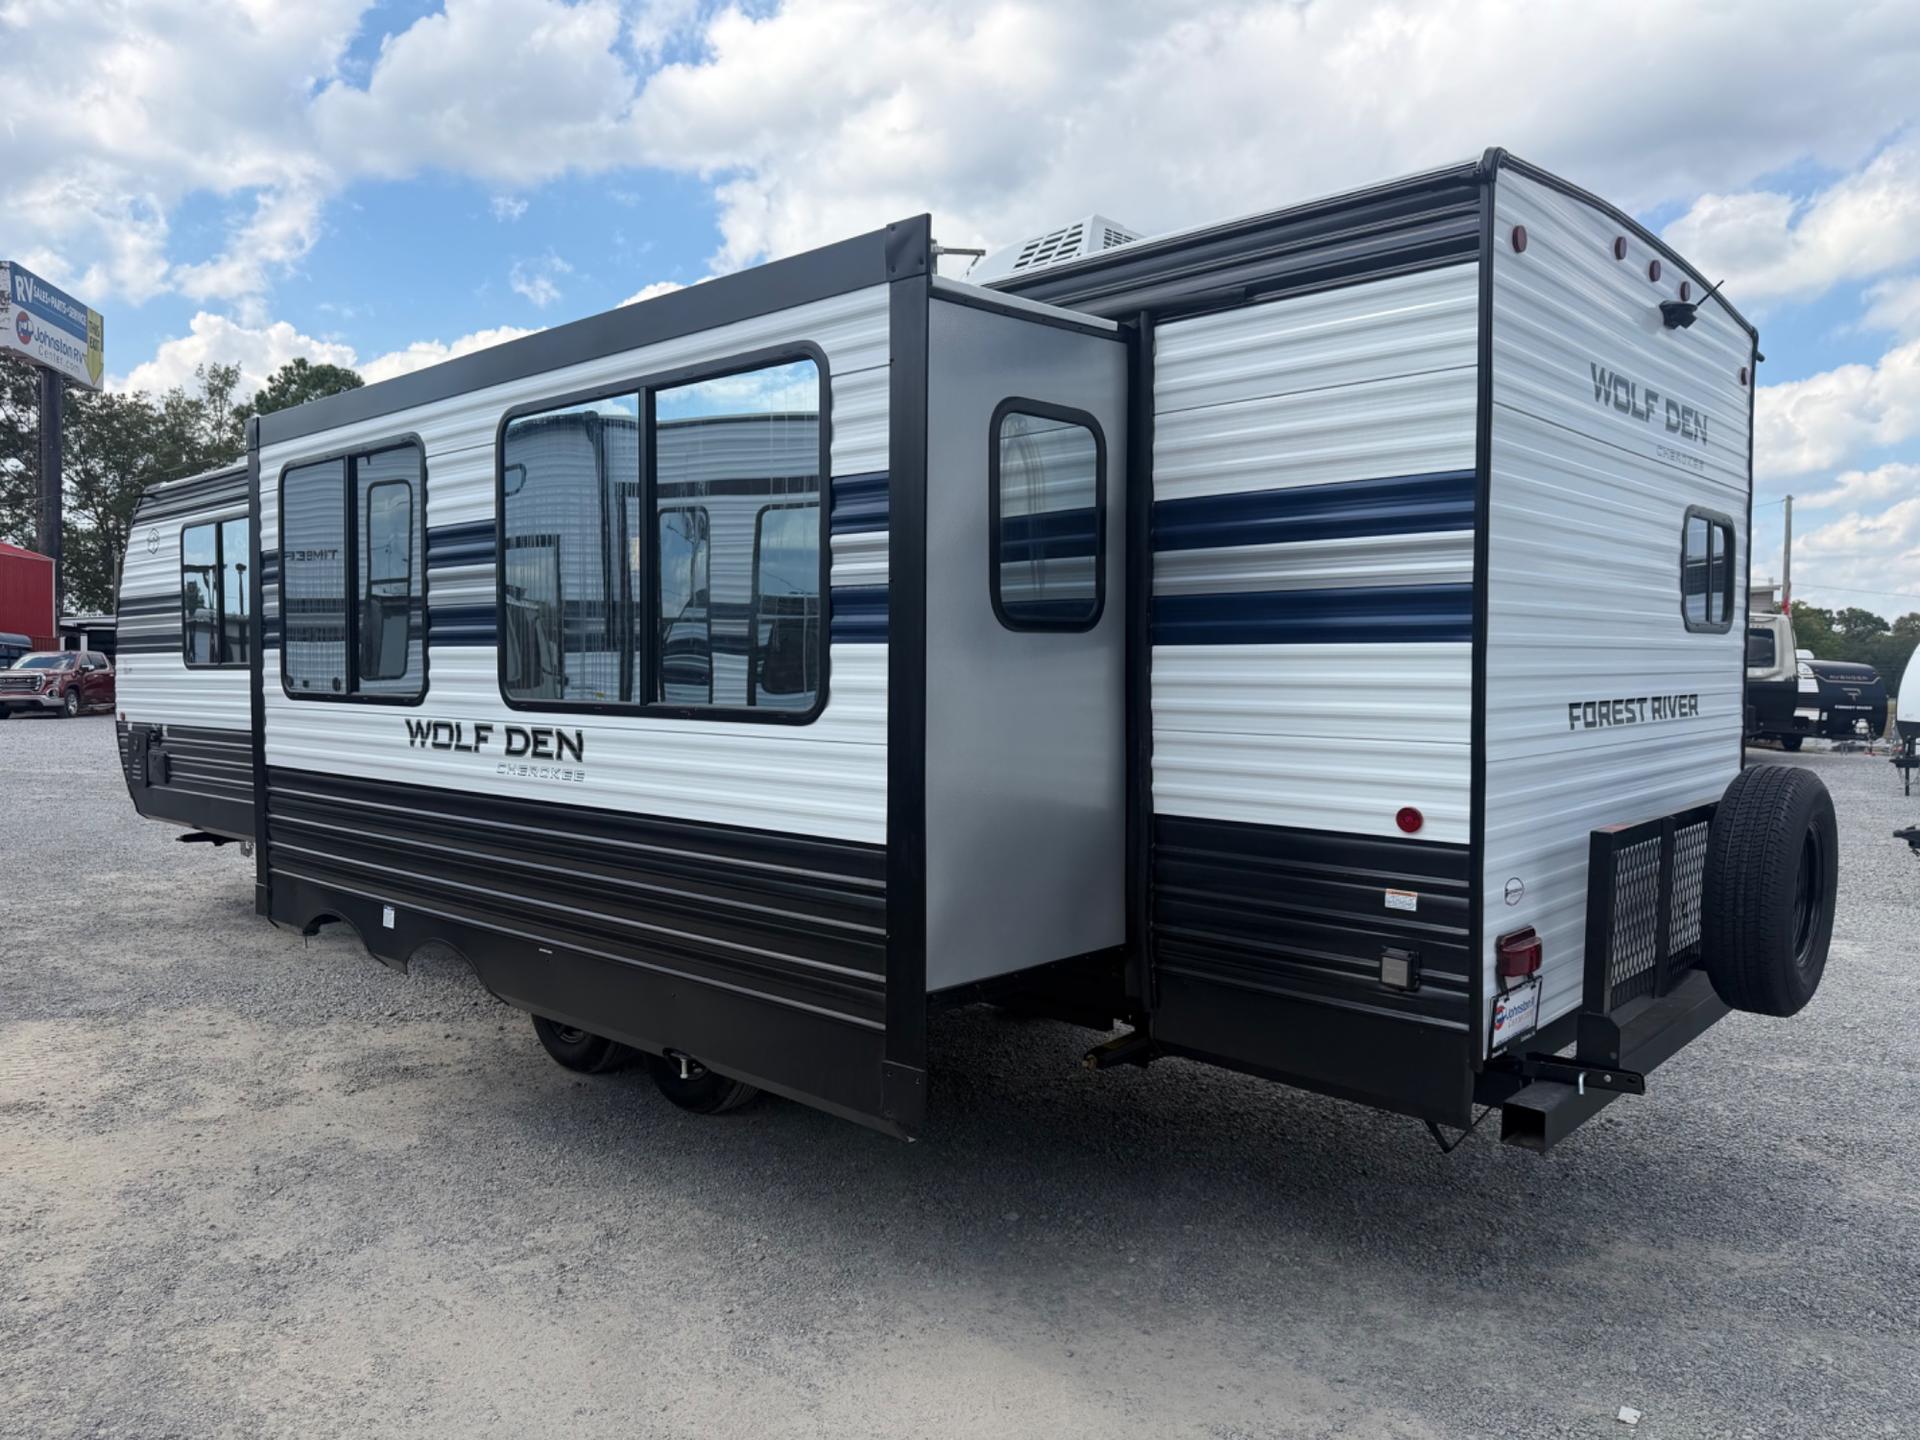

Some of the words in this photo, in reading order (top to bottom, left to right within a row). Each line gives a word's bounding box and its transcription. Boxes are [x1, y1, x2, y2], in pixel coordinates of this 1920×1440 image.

[15, 274, 34, 303] RV
[34, 327, 72, 357] Johnston
[1590, 361, 1659, 422] WOLF
[1665, 398, 1709, 446] DEN
[1568, 697, 1648, 730] FOREST
[1651, 694, 1699, 721] RIVER
[405, 718, 494, 754] WOLF
[504, 725, 584, 763] DEN
[496, 762, 586, 783] CHEROKEE
